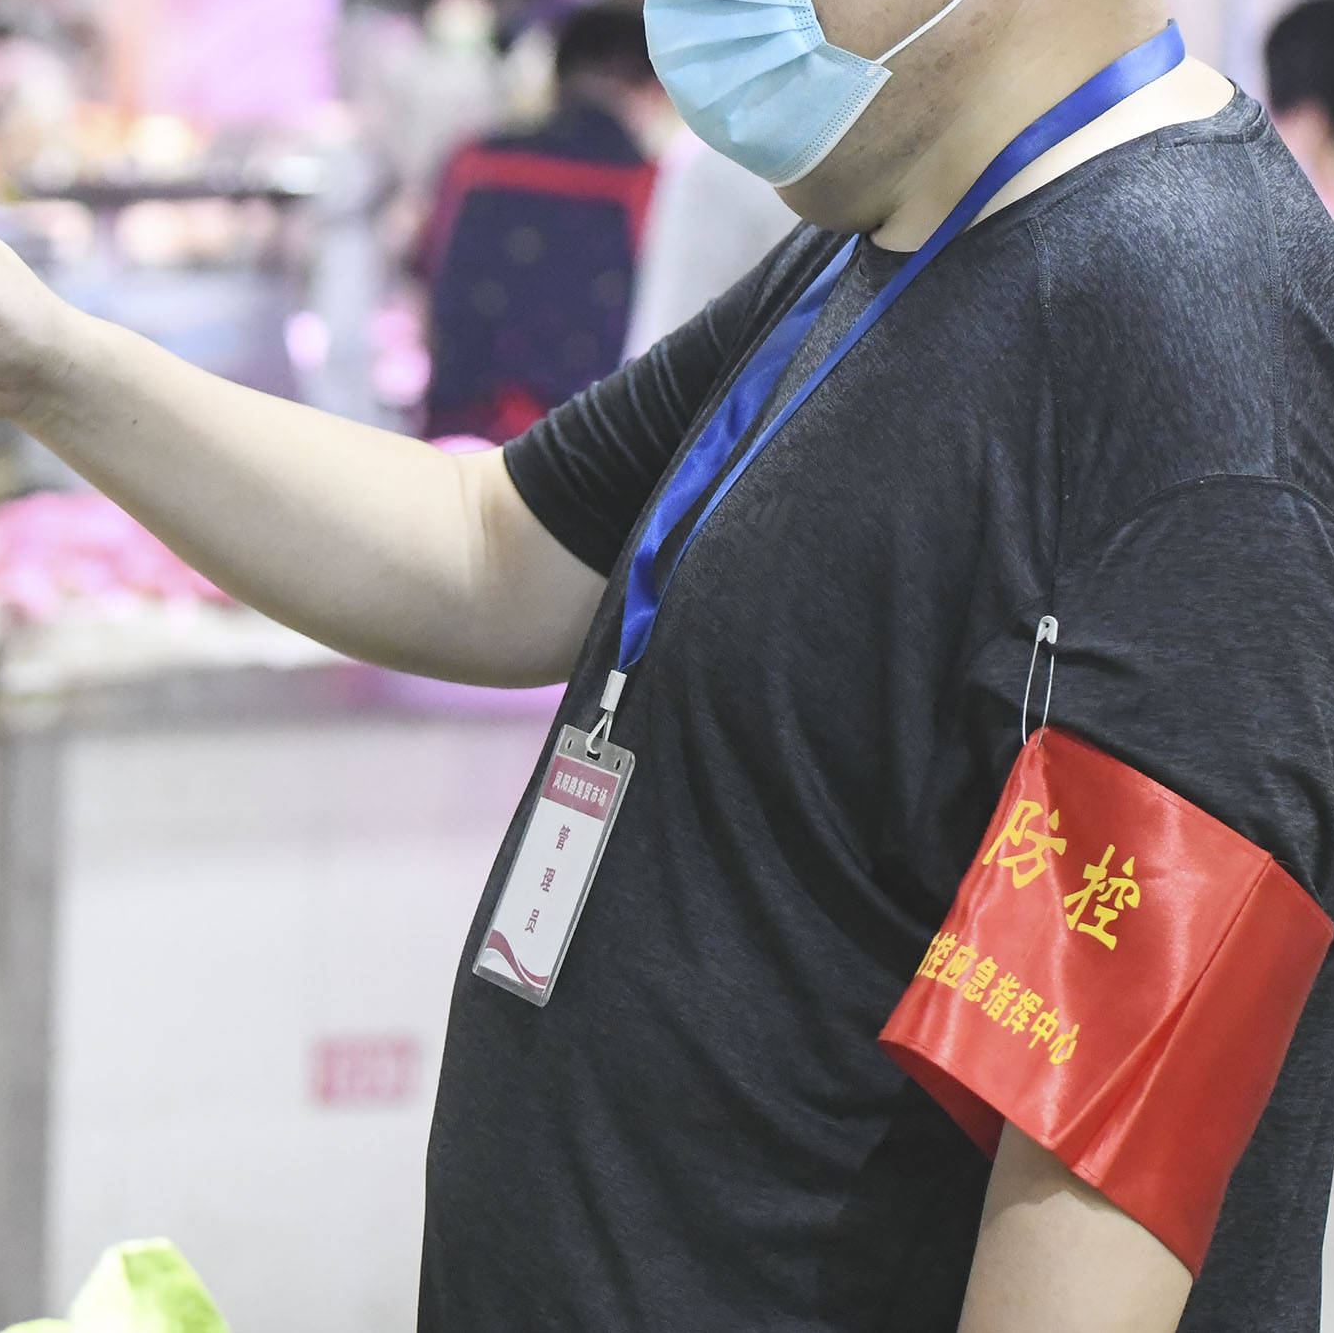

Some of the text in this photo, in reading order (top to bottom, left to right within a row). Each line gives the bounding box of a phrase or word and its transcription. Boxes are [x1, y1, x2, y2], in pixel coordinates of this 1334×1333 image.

[982, 800, 1141, 950] 防控
[915, 931, 1080, 1065] 控应急指挥中心
